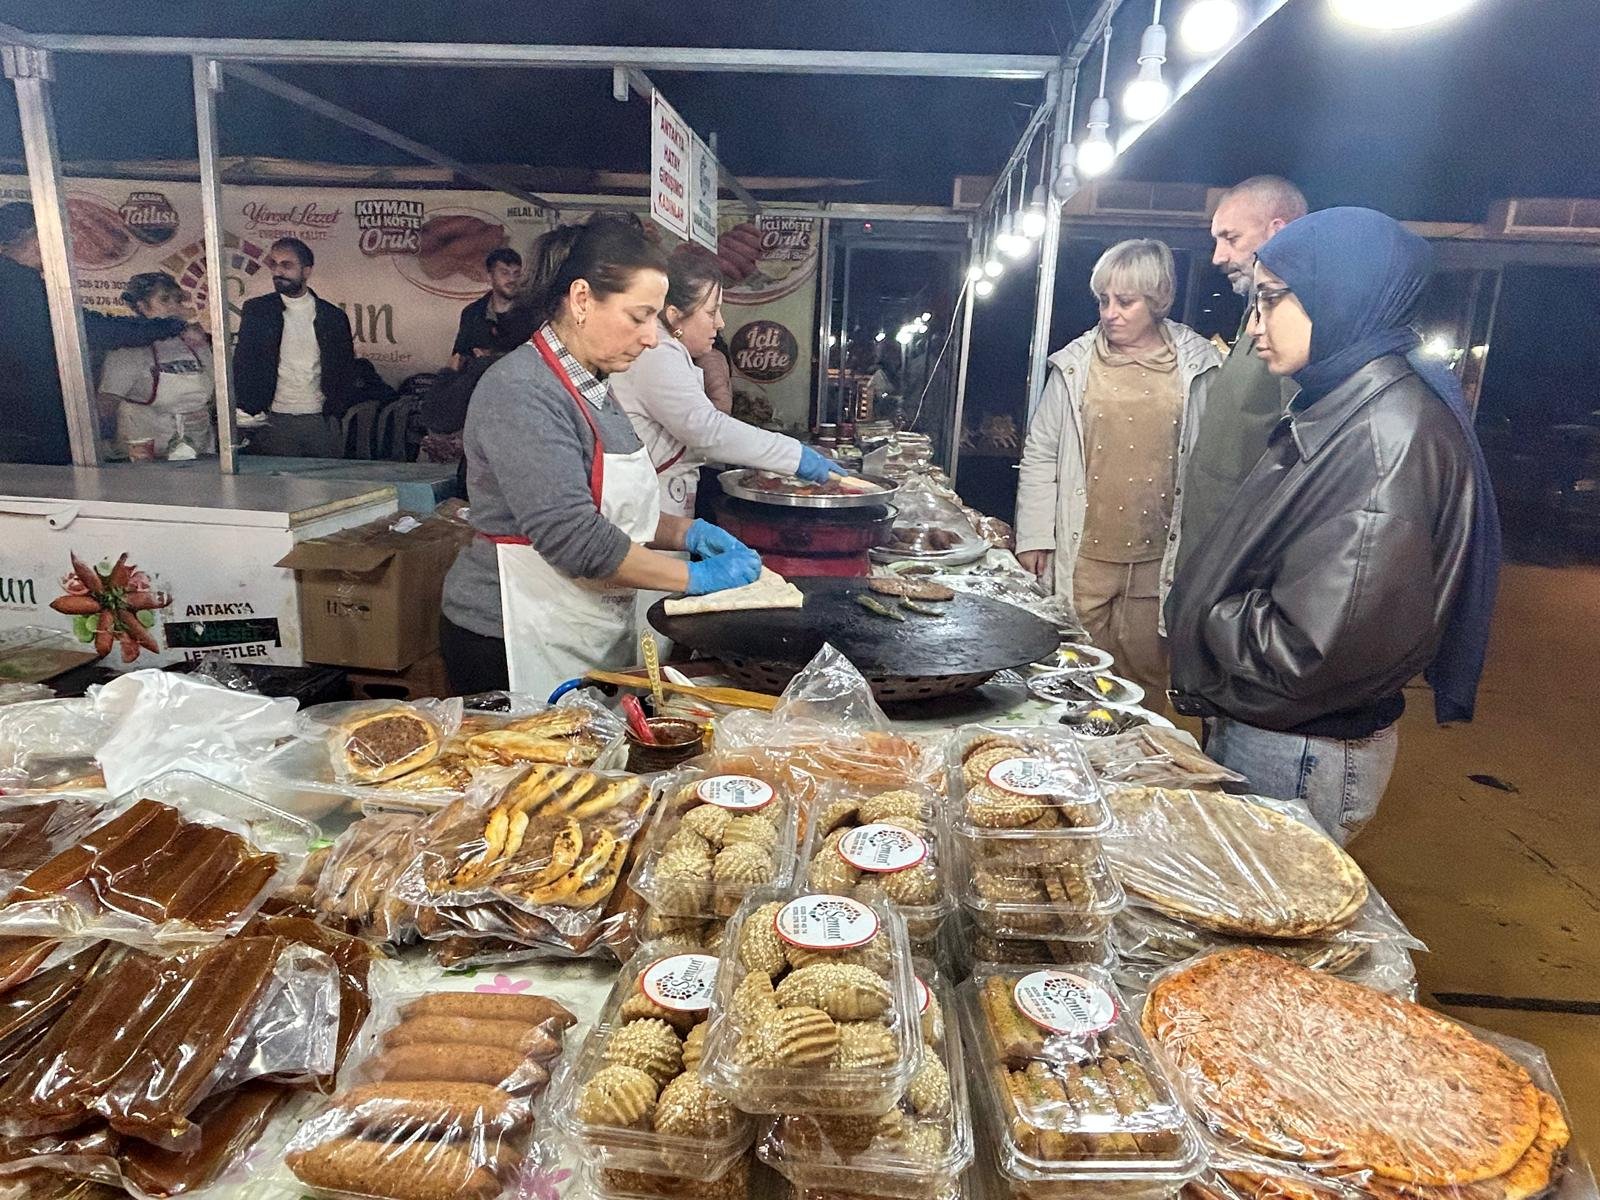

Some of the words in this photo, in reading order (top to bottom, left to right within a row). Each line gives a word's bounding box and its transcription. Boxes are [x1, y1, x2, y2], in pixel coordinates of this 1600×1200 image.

[292, 202, 343, 228] Lezzet
[356, 201, 422, 216] KIYMALI
[383, 215, 420, 229] KÖFTE
[362, 229, 418, 251] Oruk
[747, 325, 781, 351] İçli
[737, 350, 791, 371] Köfte
[186, 602, 255, 617] ANTAKYA
[876, 839, 901, 864] Semun
[825, 910, 845, 940] Semun
[671, 959, 703, 990] Semun
[1059, 989, 1089, 1023] Semun
